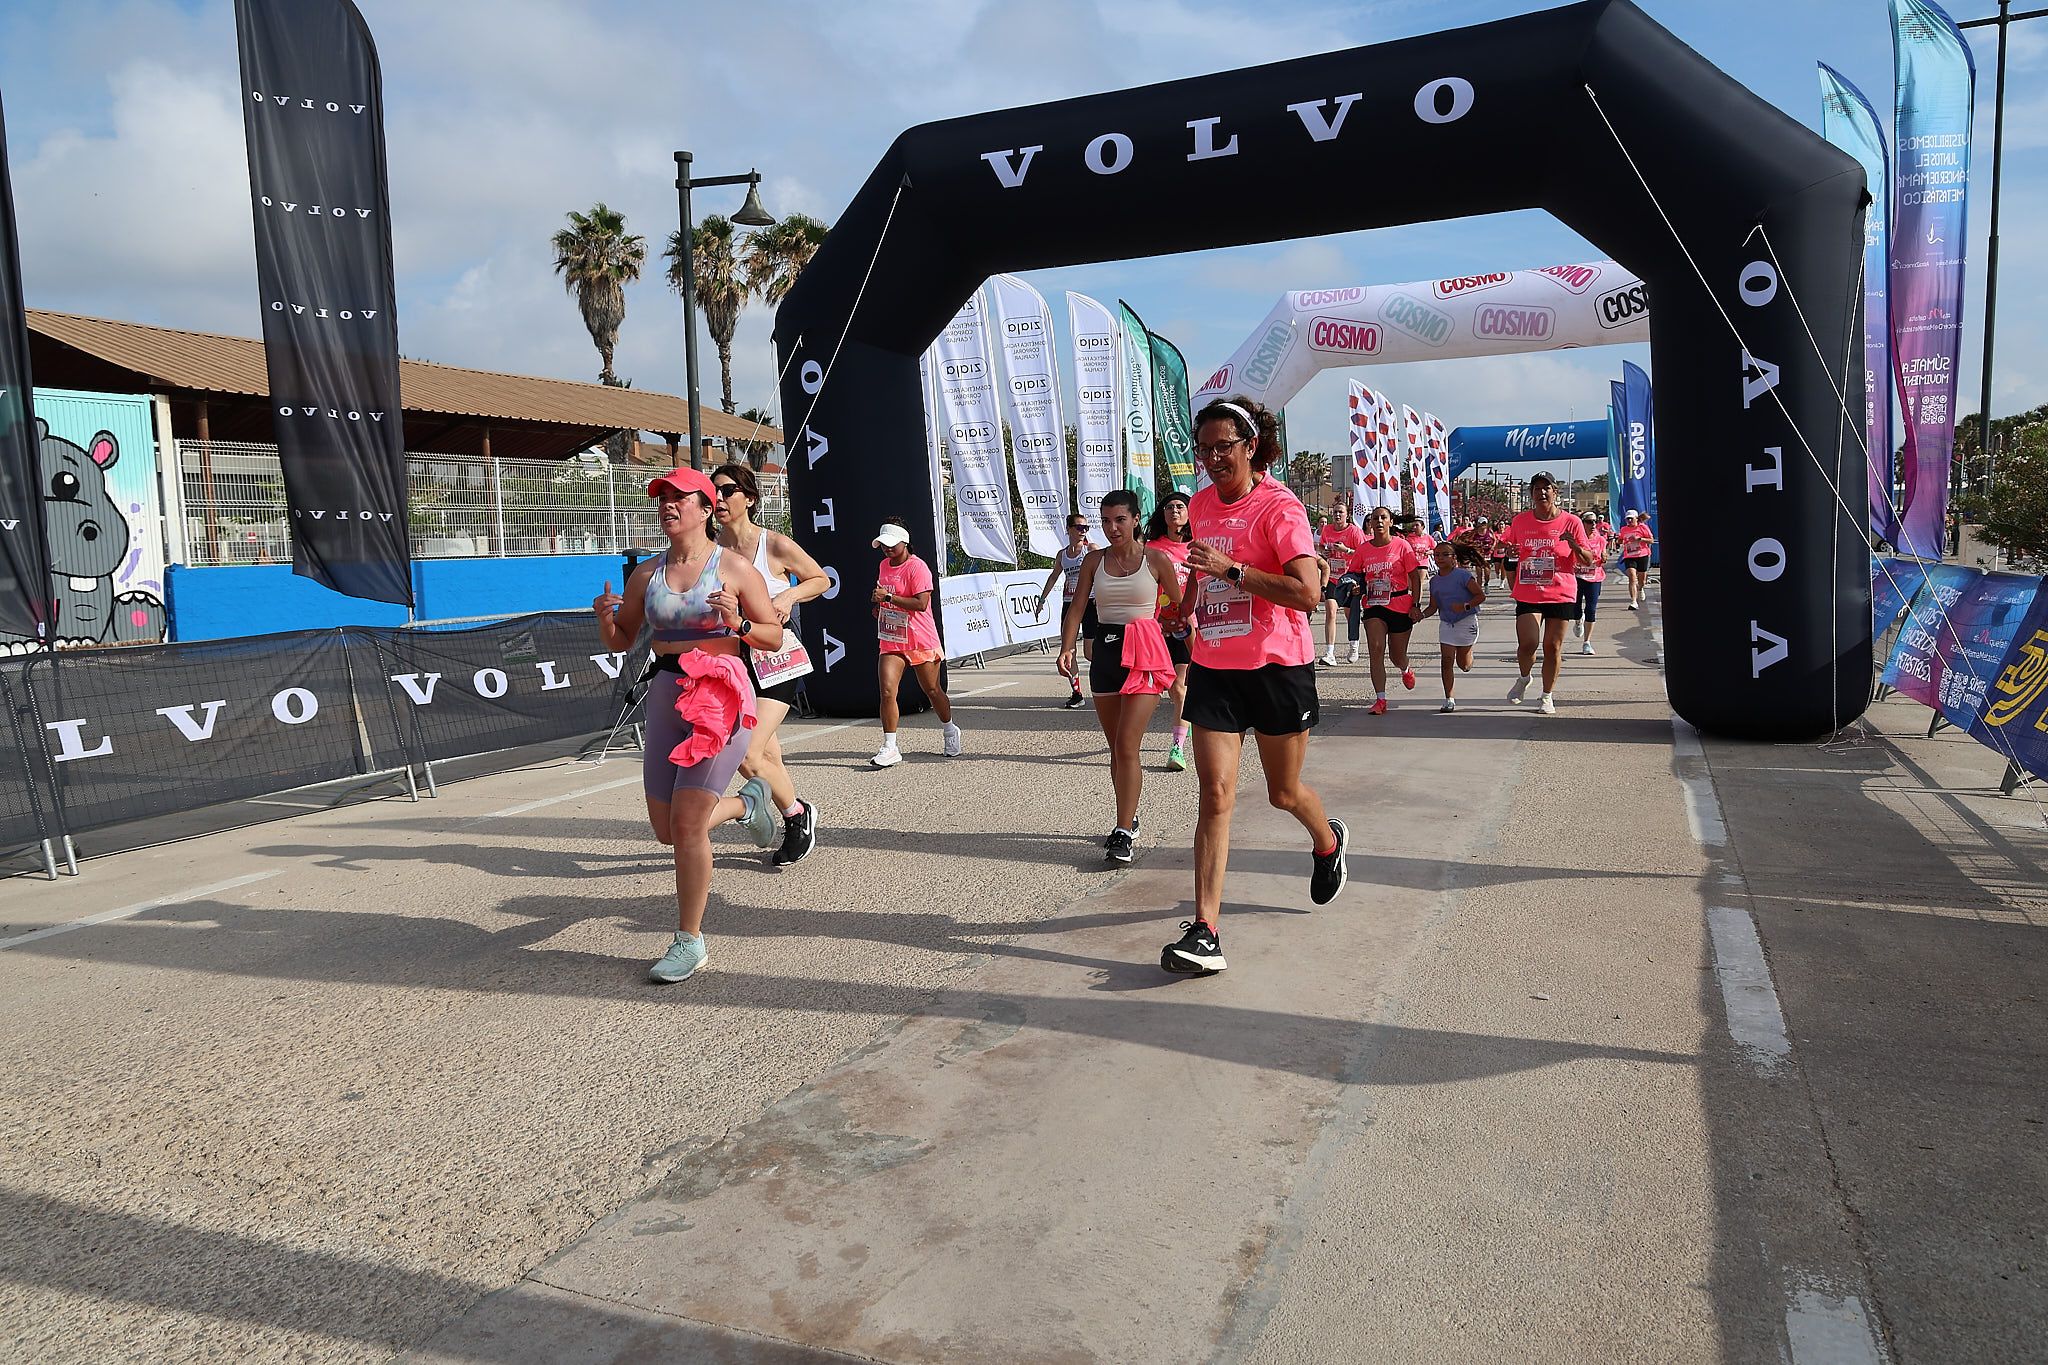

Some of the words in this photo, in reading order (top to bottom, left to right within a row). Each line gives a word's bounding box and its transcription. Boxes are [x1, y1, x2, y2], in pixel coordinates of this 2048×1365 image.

[981, 77, 1475, 188] VOLVO
[1603, 285, 1649, 323] COS
[1385, 297, 1448, 342] COSMO
[1480, 308, 1549, 337] COSMO
[1314, 322, 1376, 351] COSMO
[1505, 426, 1575, 456] Marlene
[1738, 260, 1788, 678] VOLVO
[801, 359, 846, 673] VOLVO
[1525, 539, 1555, 547] CARRERA
[1366, 562, 1393, 573] CARRERA
[1207, 603, 1229, 615] 016
[966, 618, 989, 632] ziaja.es
[770, 653, 791, 665] 016
[391, 651, 627, 705] VOLV
